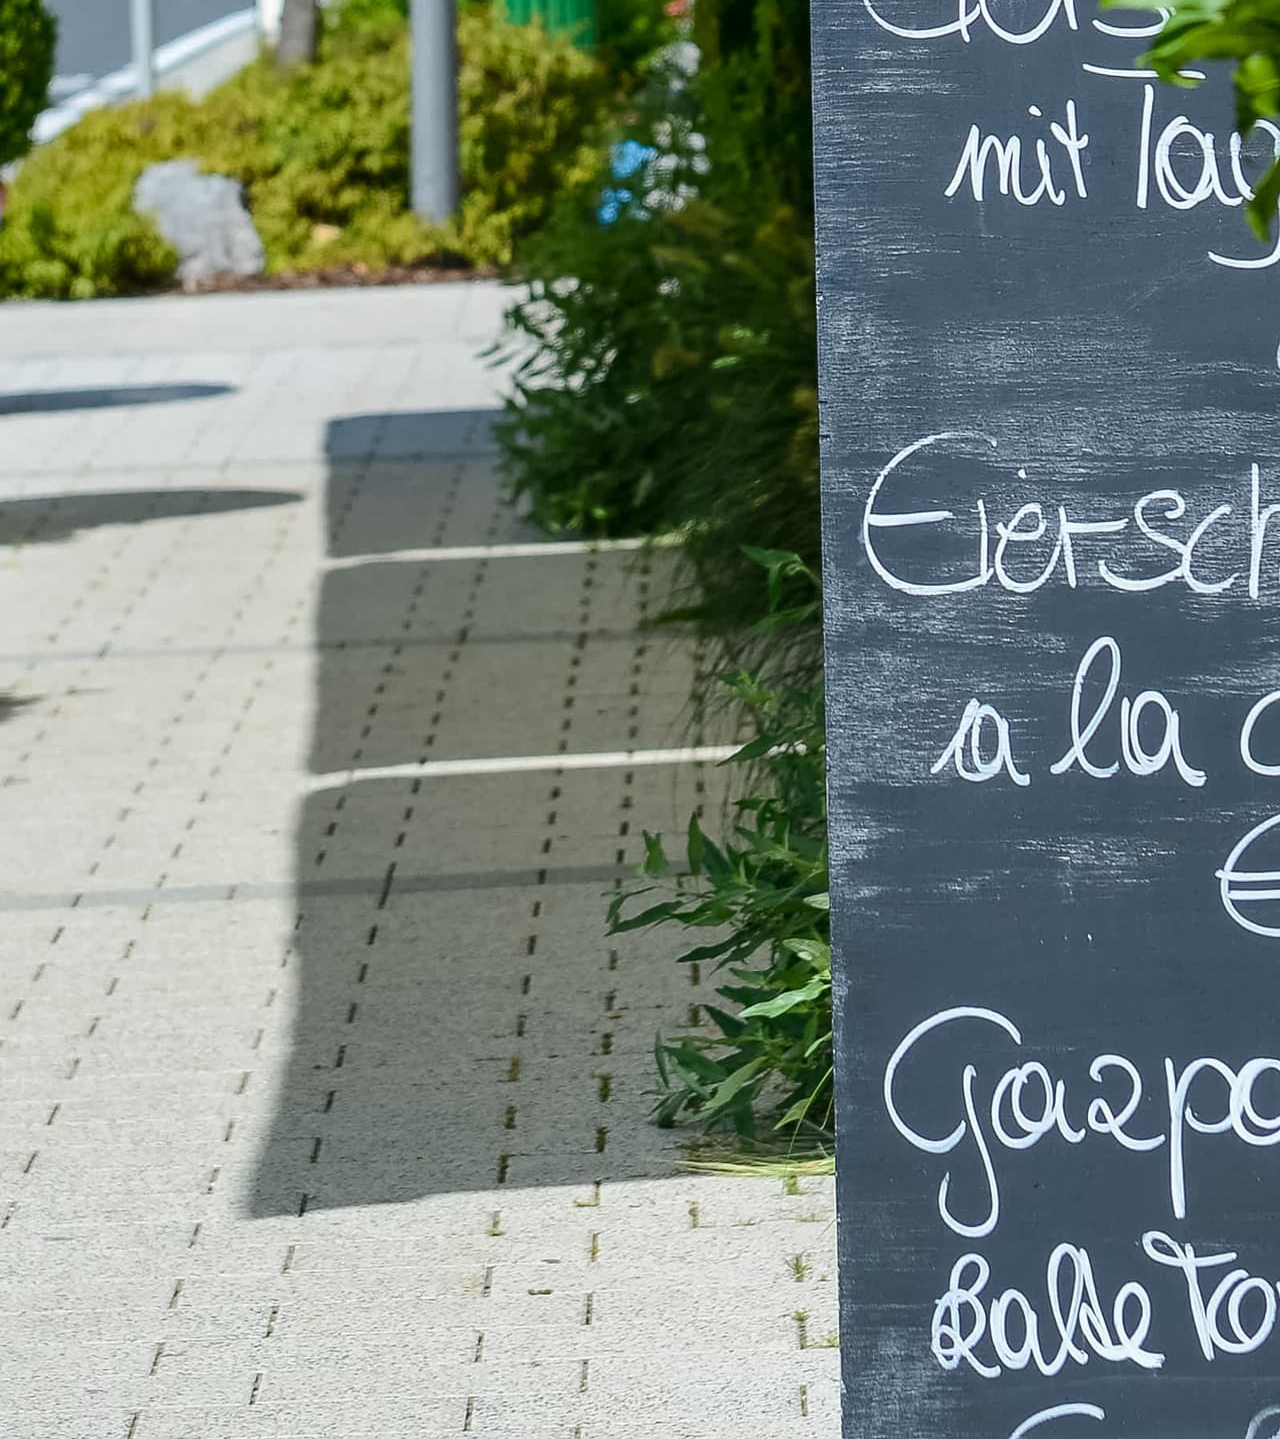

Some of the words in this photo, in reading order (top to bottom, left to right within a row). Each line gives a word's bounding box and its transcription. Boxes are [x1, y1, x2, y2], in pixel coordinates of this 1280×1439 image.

[944, 98, 1089, 206] mit
[930, 698, 1031, 787] a
[1050, 635, 1208, 787] la
